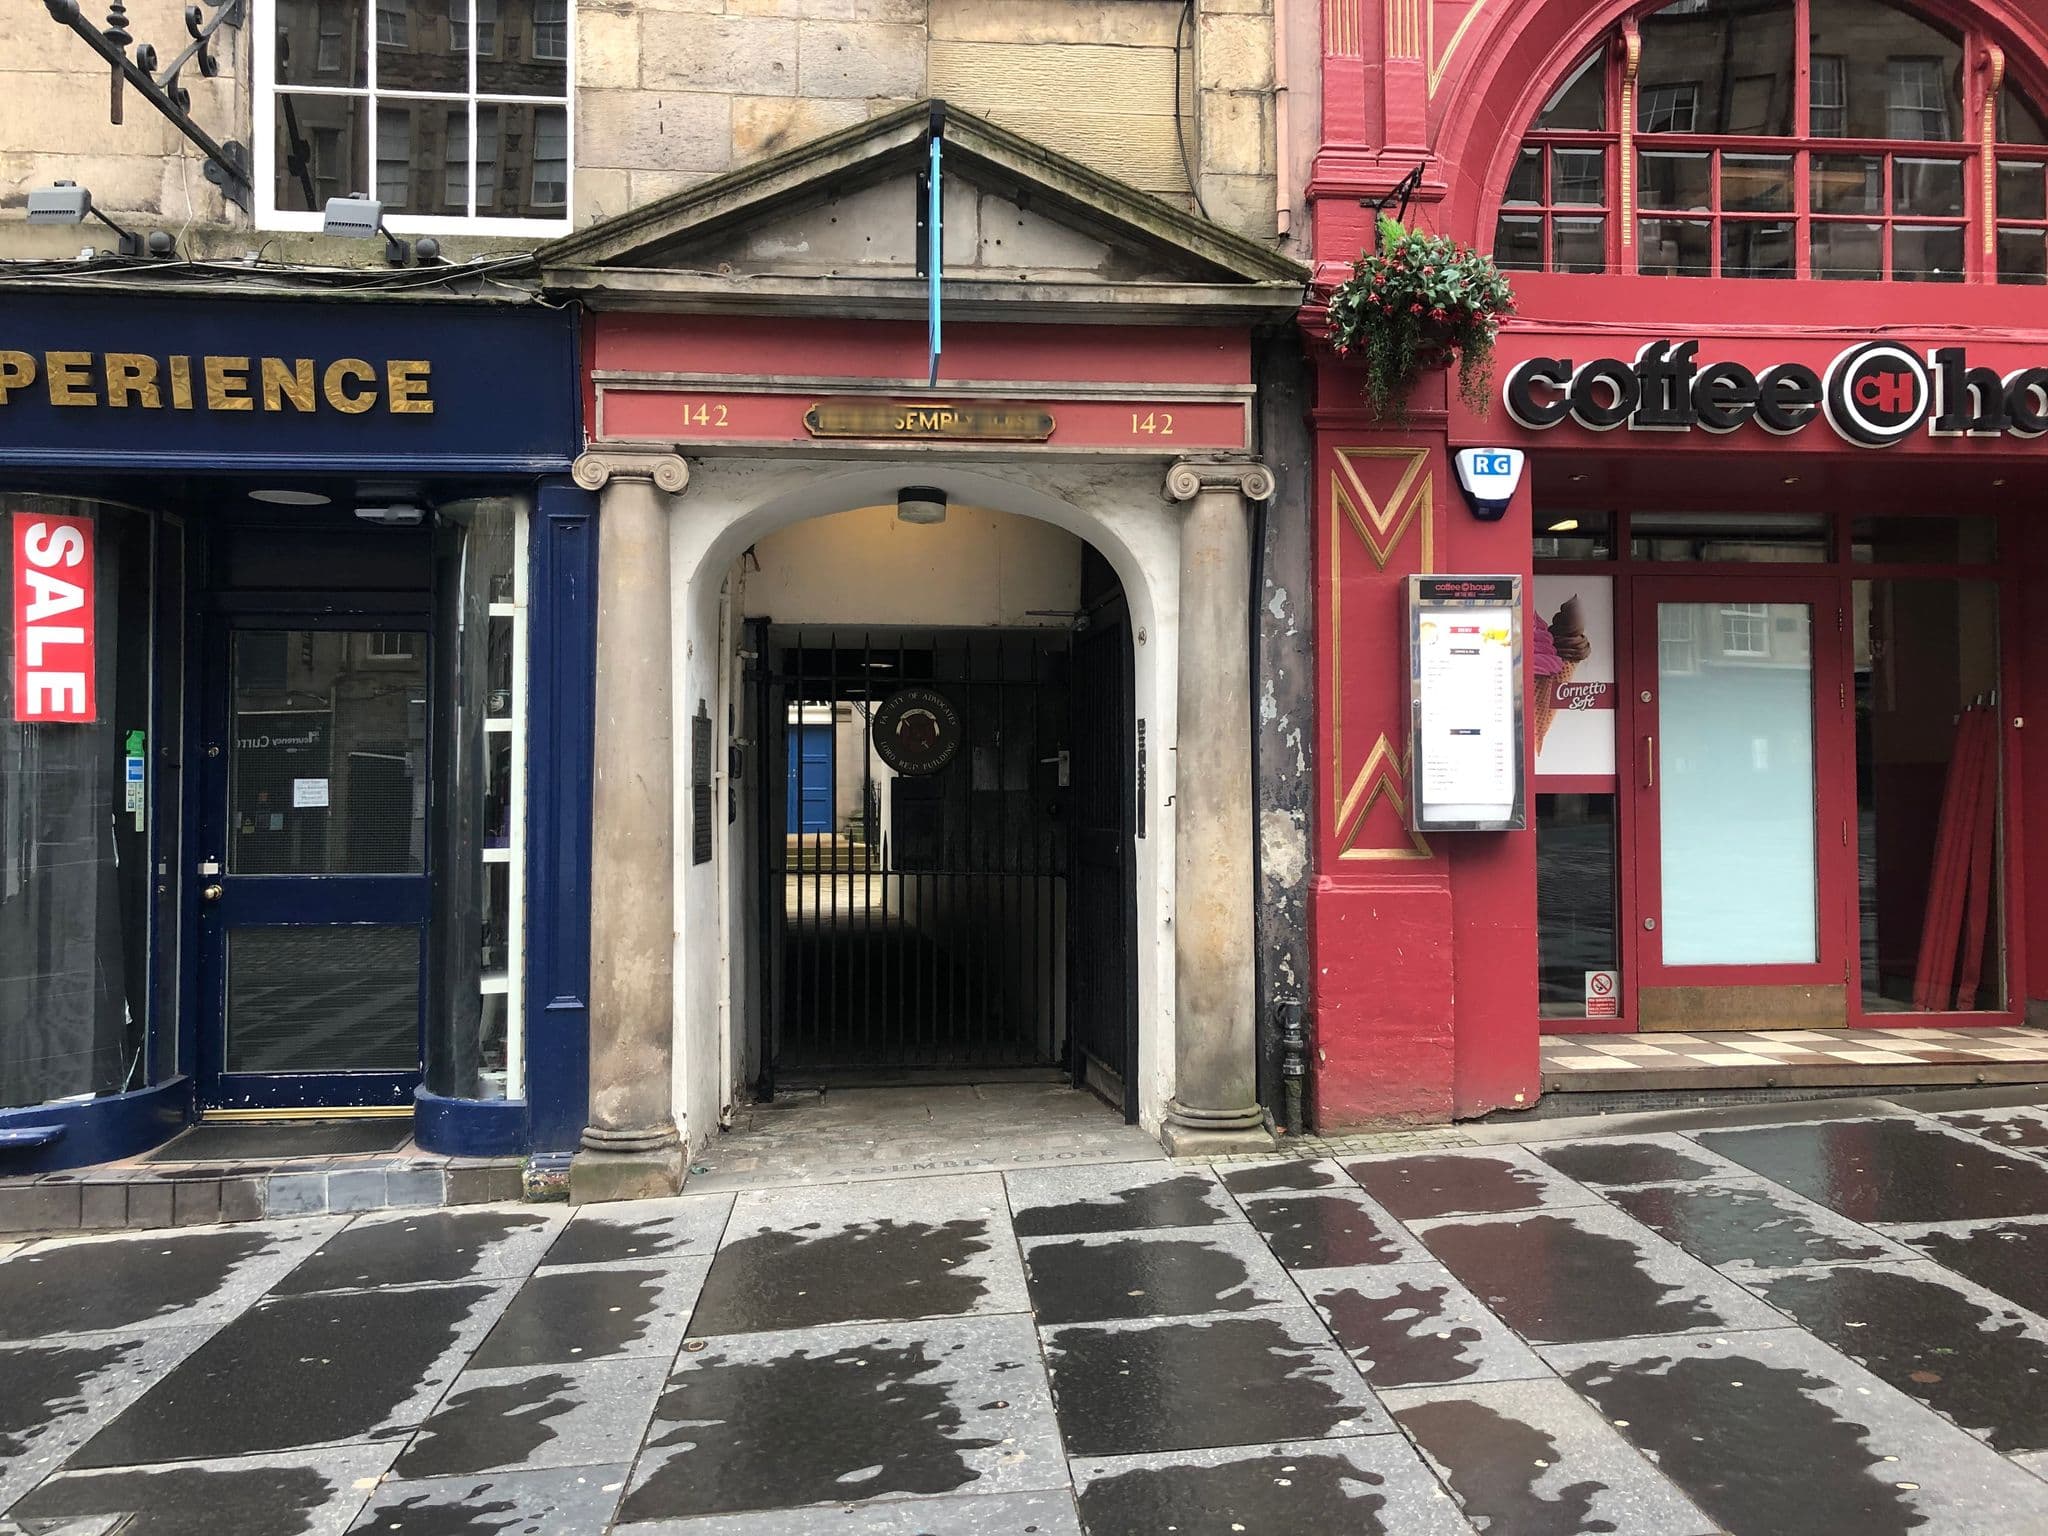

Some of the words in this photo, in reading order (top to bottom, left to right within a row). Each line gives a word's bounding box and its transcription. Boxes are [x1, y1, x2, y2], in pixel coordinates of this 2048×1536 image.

[0, 350, 434, 414] PERIENCE
[1503, 340, 1824, 435] coffee
[1856, 371, 1913, 413] CH
[1928, 347, 2048, 438] ho
[683, 403, 729, 427] 142
[1132, 412, 1173, 434] 142
[1476, 456, 1509, 473] RG
[1435, 582, 1460, 591] coffee
[1469, 582, 1496, 591] house
[25, 522, 86, 715] SALE
[1556, 681, 1606, 700] Cornetto
[1569, 694, 1596, 711] Soft
